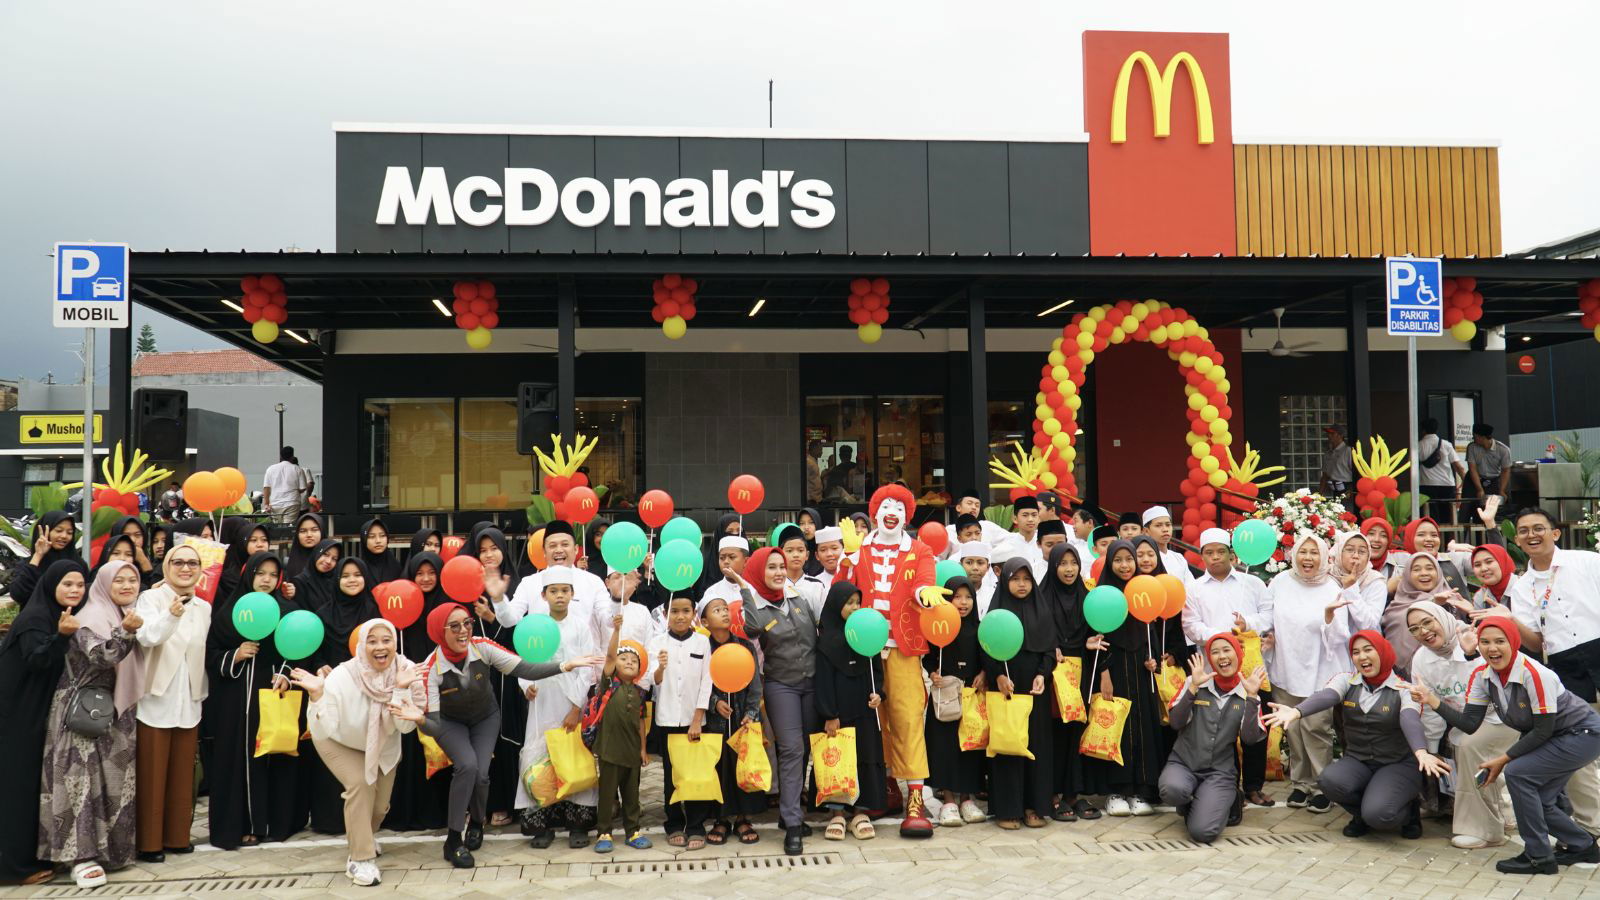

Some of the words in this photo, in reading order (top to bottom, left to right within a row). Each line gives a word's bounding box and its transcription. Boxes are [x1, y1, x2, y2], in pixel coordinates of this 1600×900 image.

[375, 165, 836, 229] McDonald's
[61, 249, 100, 294] P
[1390, 262, 1416, 299] P
[63, 307, 119, 320] MOBIL
[1400, 310, 1429, 320] PARKIR
[1391, 321, 1439, 331] DISABILITAS
[46, 423, 95, 435] Mushol
